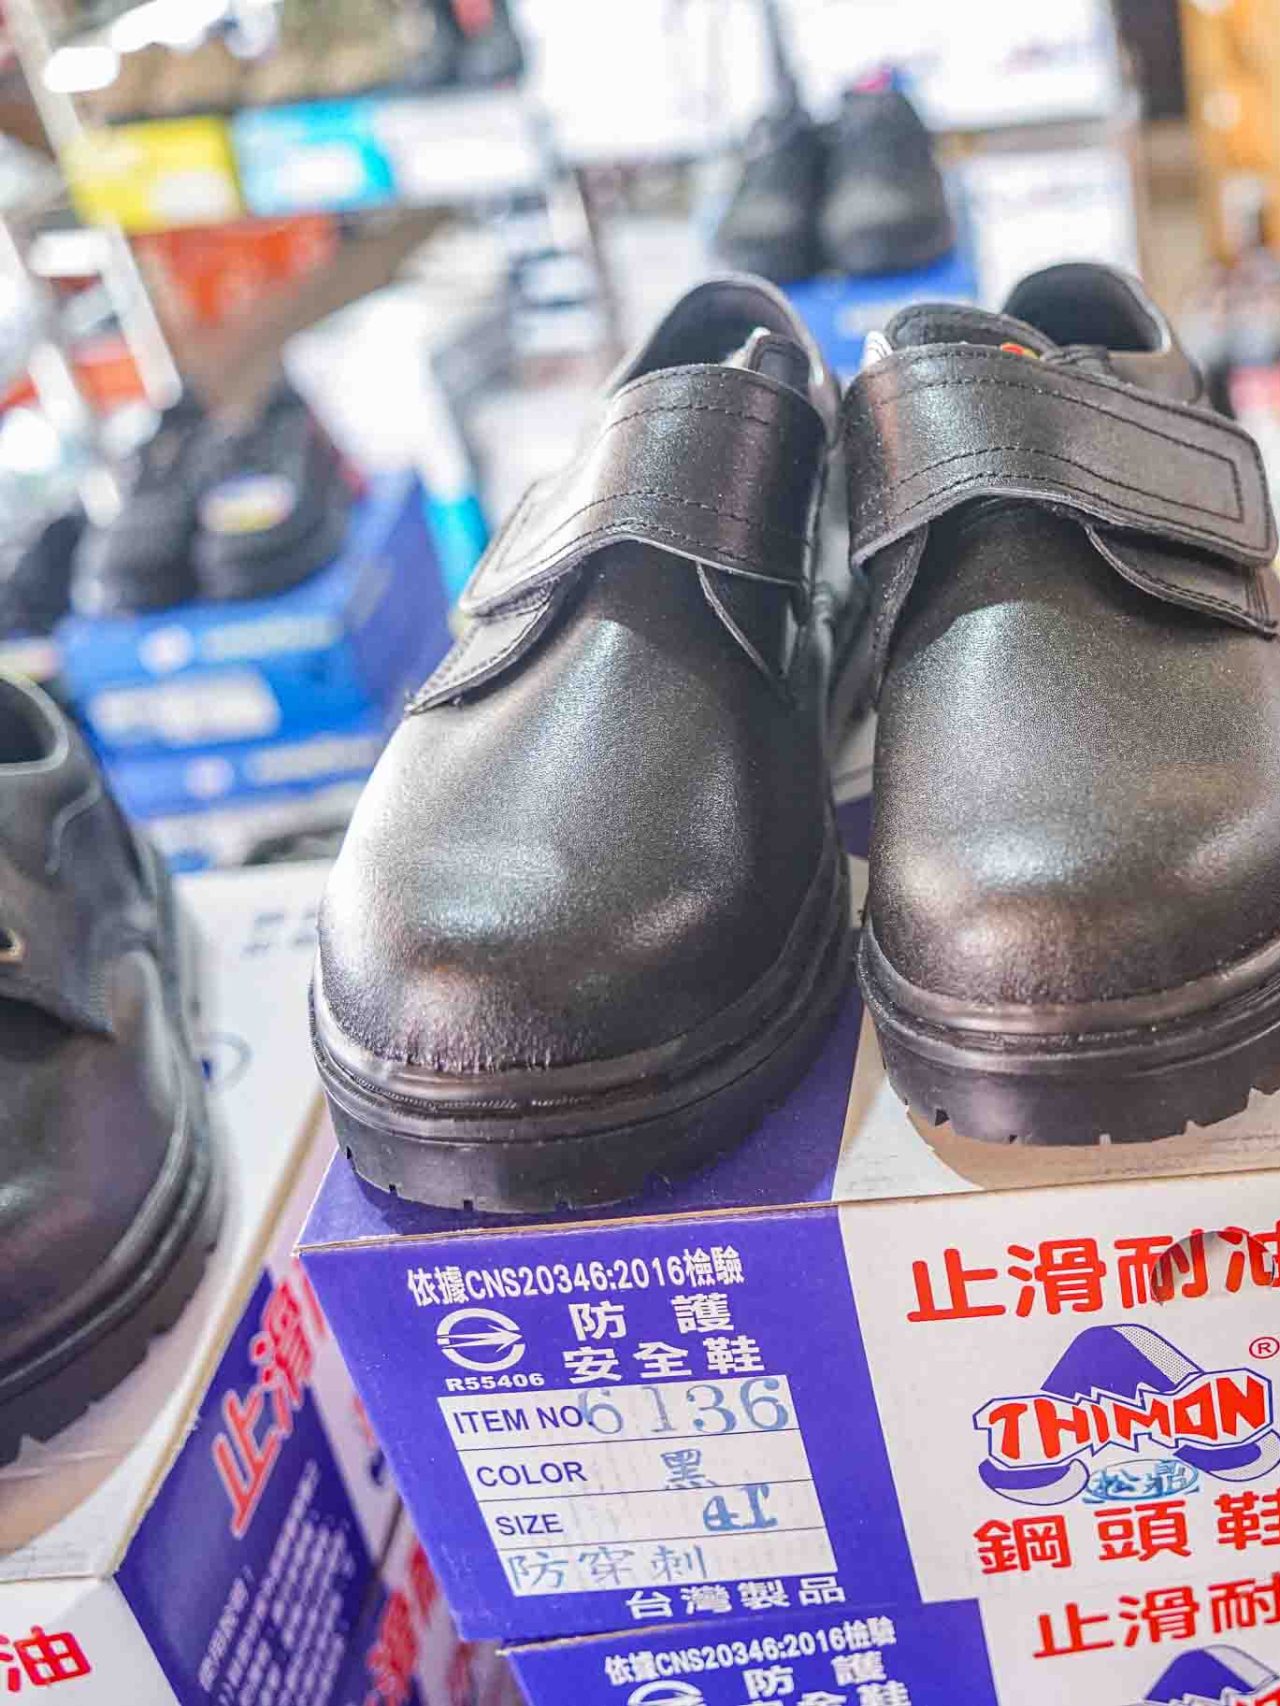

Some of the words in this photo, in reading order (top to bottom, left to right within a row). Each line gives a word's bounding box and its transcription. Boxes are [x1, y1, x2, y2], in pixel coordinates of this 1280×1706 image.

[407, 1246, 744, 1307] 依據CNS20346:2016檢驗
[445, 1372, 545, 1392] R55406
[562, 1336, 764, 1384] 安全鞋
[453, 1408, 531, 1435] ITEM
[579, 1377, 789, 1435] 6136
[989, 1375, 1265, 1459] THIMON
[476, 1461, 587, 1488] COLOR
[660, 1448, 719, 1490] 黑
[495, 1513, 564, 1536] SIZE
[507, 1544, 707, 1590] 防穿刺
[626, 1577, 846, 1620] 台灣製品
